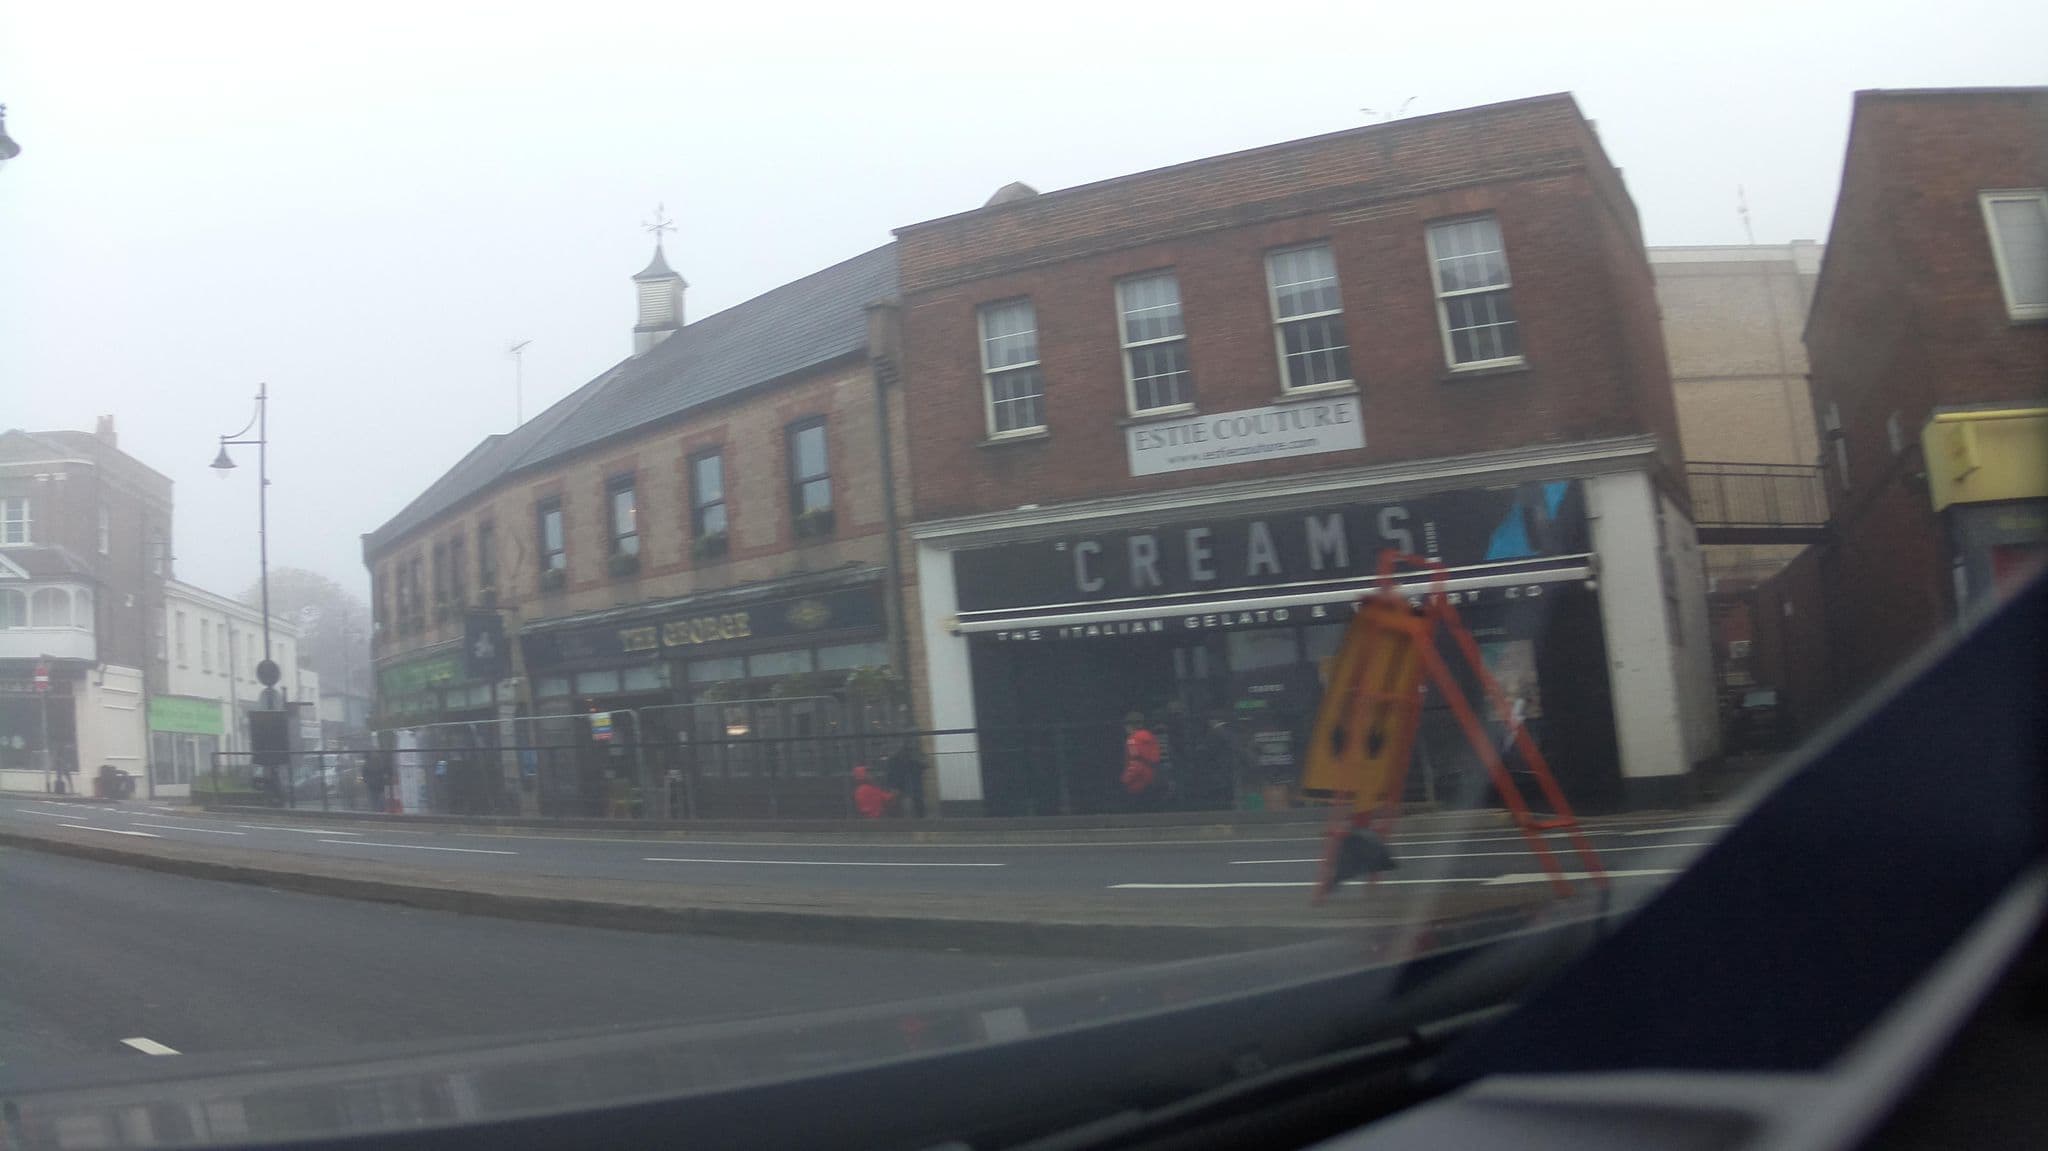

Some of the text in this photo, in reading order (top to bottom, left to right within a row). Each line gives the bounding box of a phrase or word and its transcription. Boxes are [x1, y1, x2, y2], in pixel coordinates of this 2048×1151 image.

[1135, 402, 1353, 451] ESTIE COUTURE
[1072, 506, 1415, 593] CREAMS
[997, 629, 1042, 641] THE
[1058, 619, 1164, 639] ITALIAN
[1184, 608, 1291, 629] GELATO
